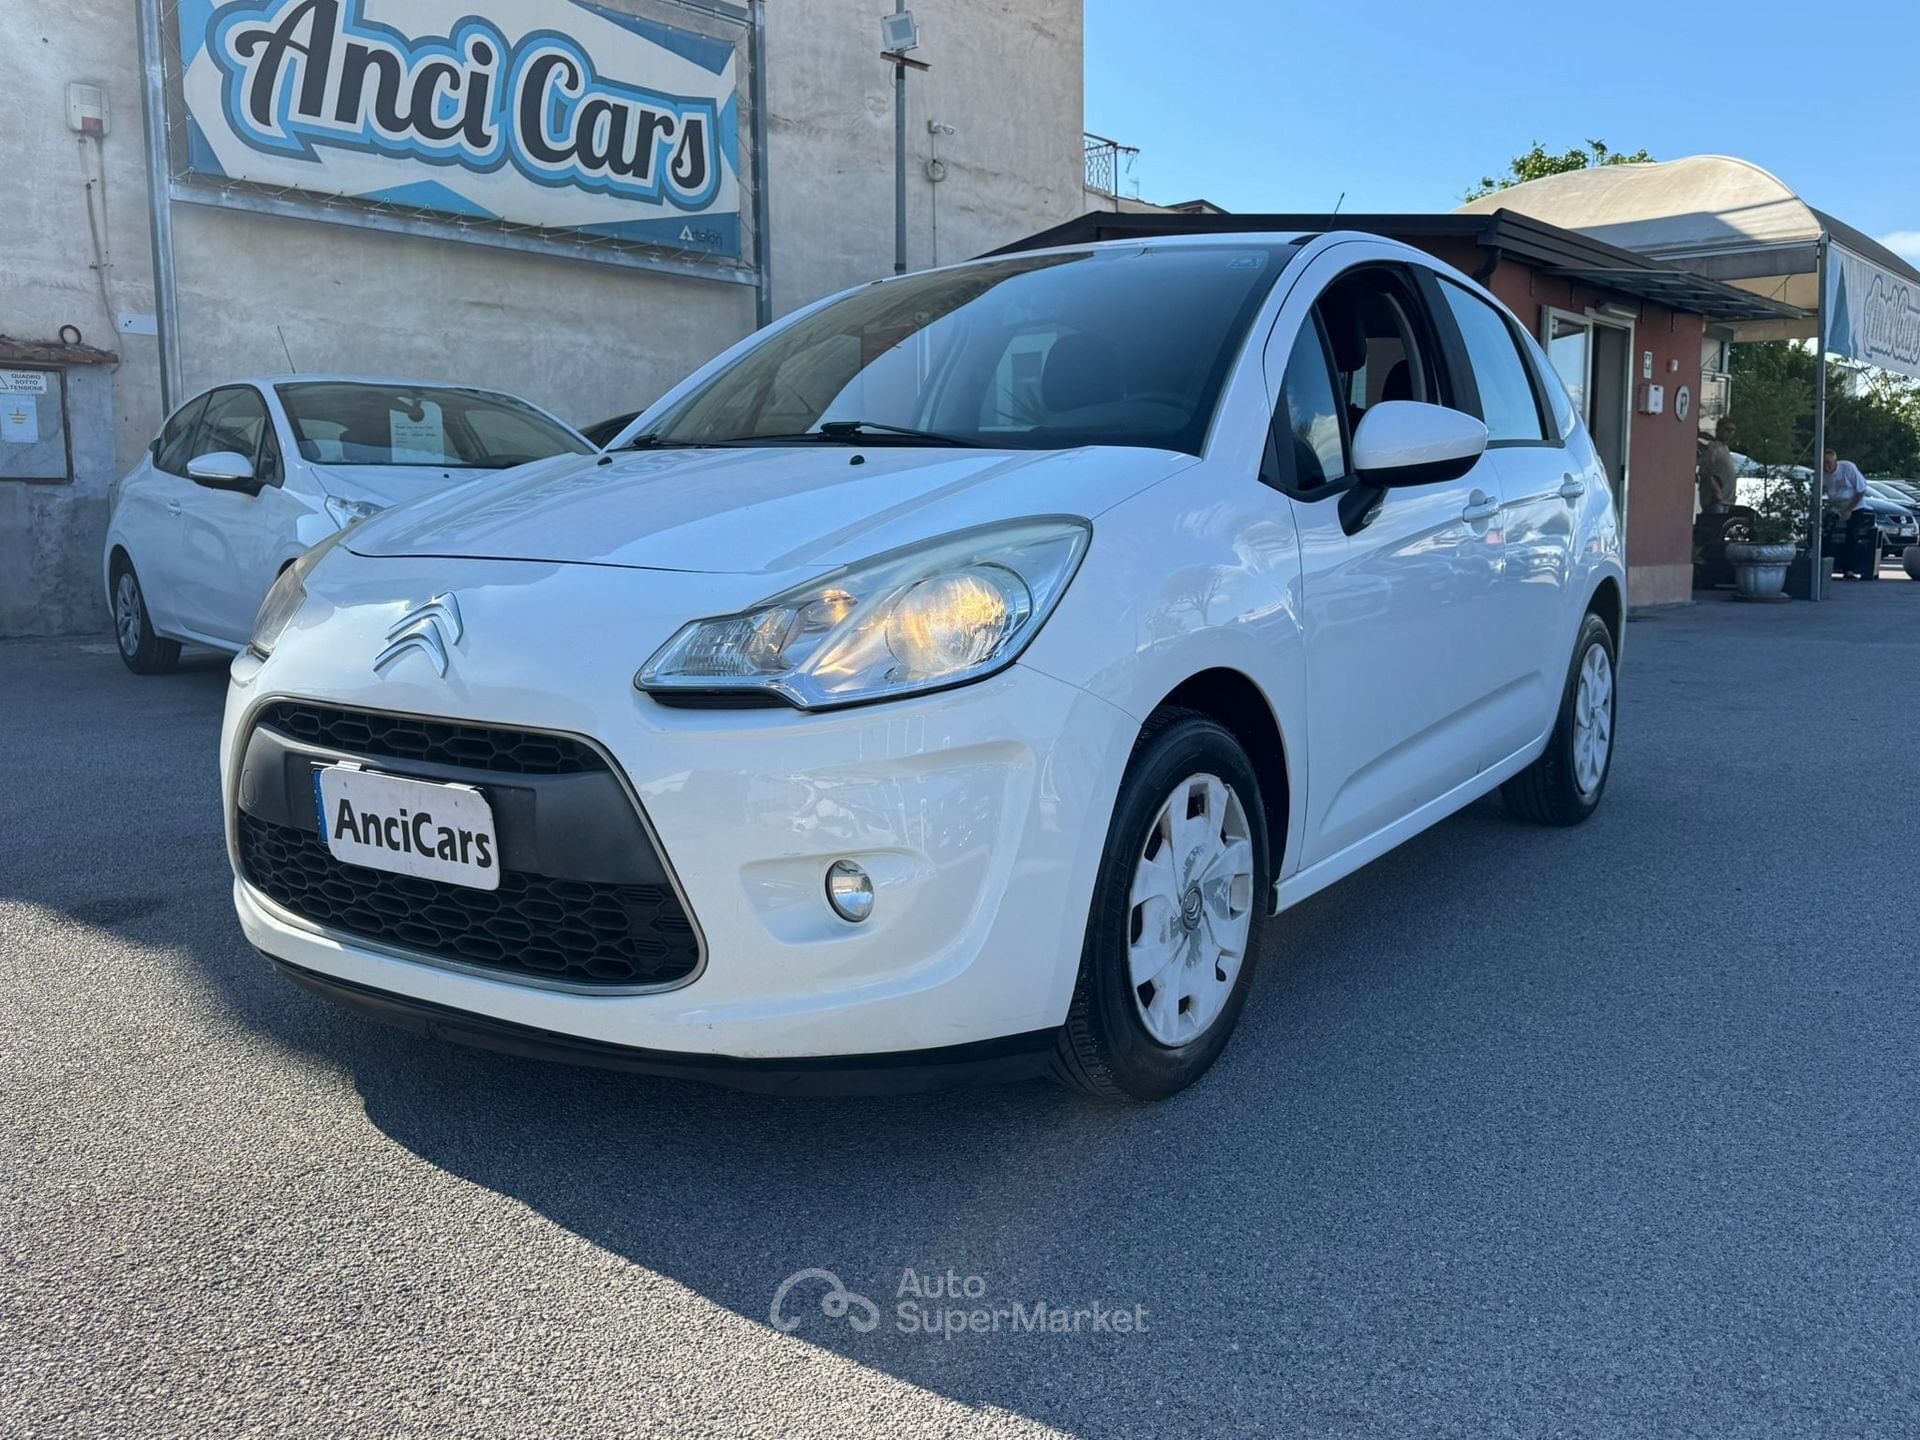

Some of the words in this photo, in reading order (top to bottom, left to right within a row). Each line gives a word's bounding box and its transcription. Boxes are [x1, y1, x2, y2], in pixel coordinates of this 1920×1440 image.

[234, 0, 493, 149] Anci
[520, 54, 706, 189] Cars
[335, 798, 492, 868] AnciCars
